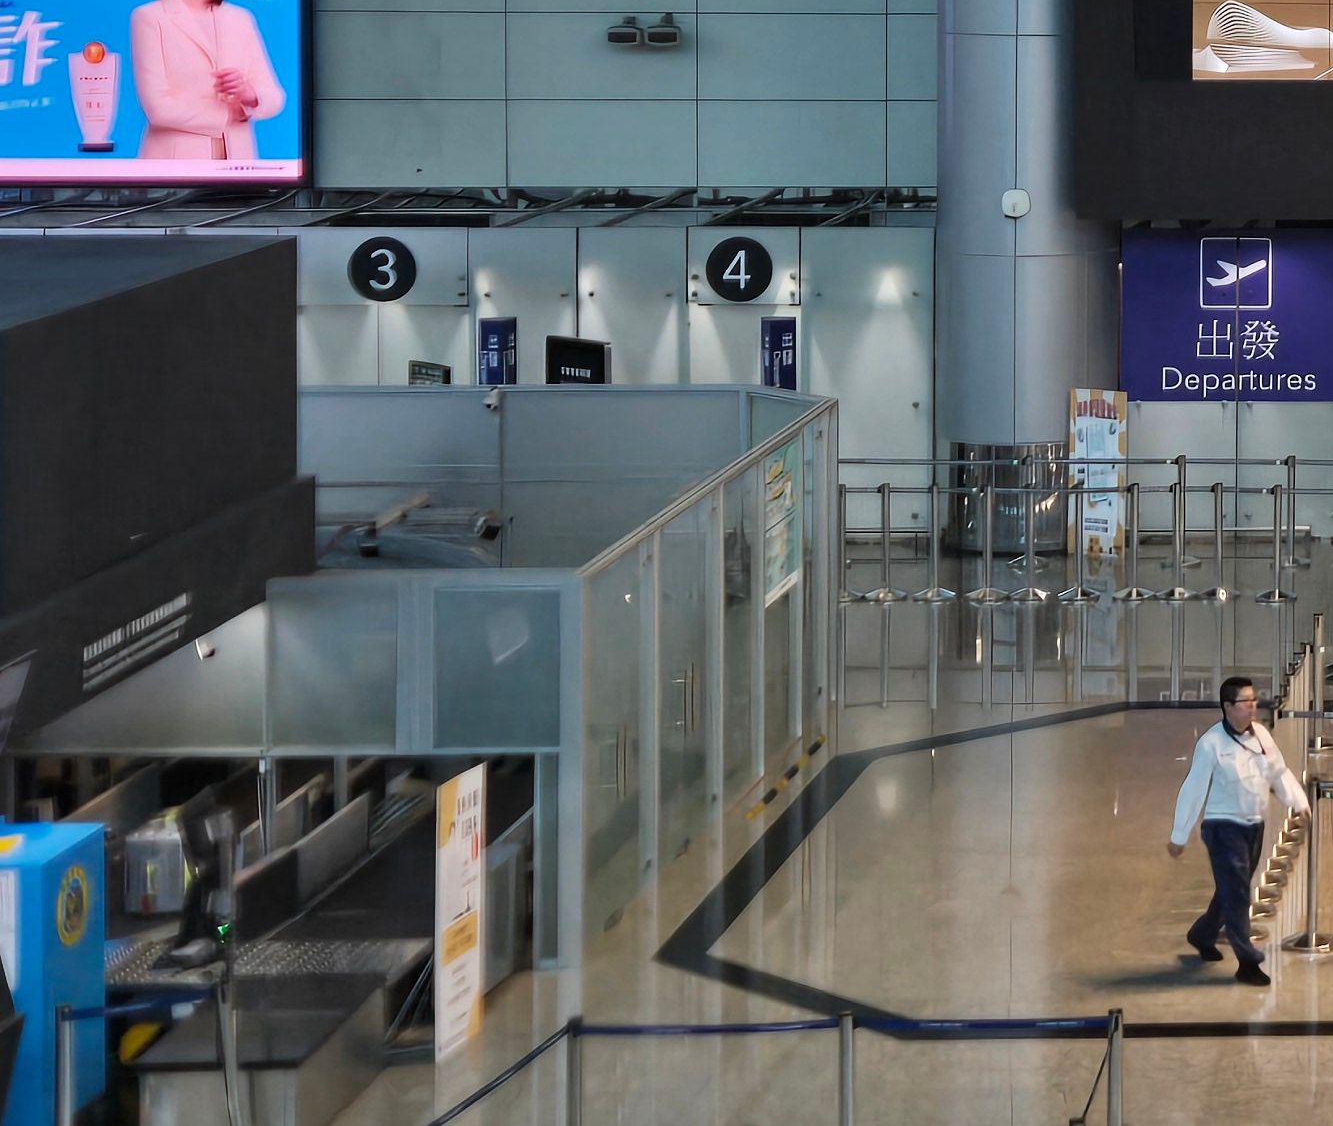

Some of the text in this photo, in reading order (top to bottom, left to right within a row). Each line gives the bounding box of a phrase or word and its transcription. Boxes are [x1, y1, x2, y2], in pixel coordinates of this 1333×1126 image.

[369, 248, 396, 290] 3
[722, 249, 752, 290] 4
[1196, 319, 1280, 361] 出發
[1161, 366, 1317, 398] Departures
